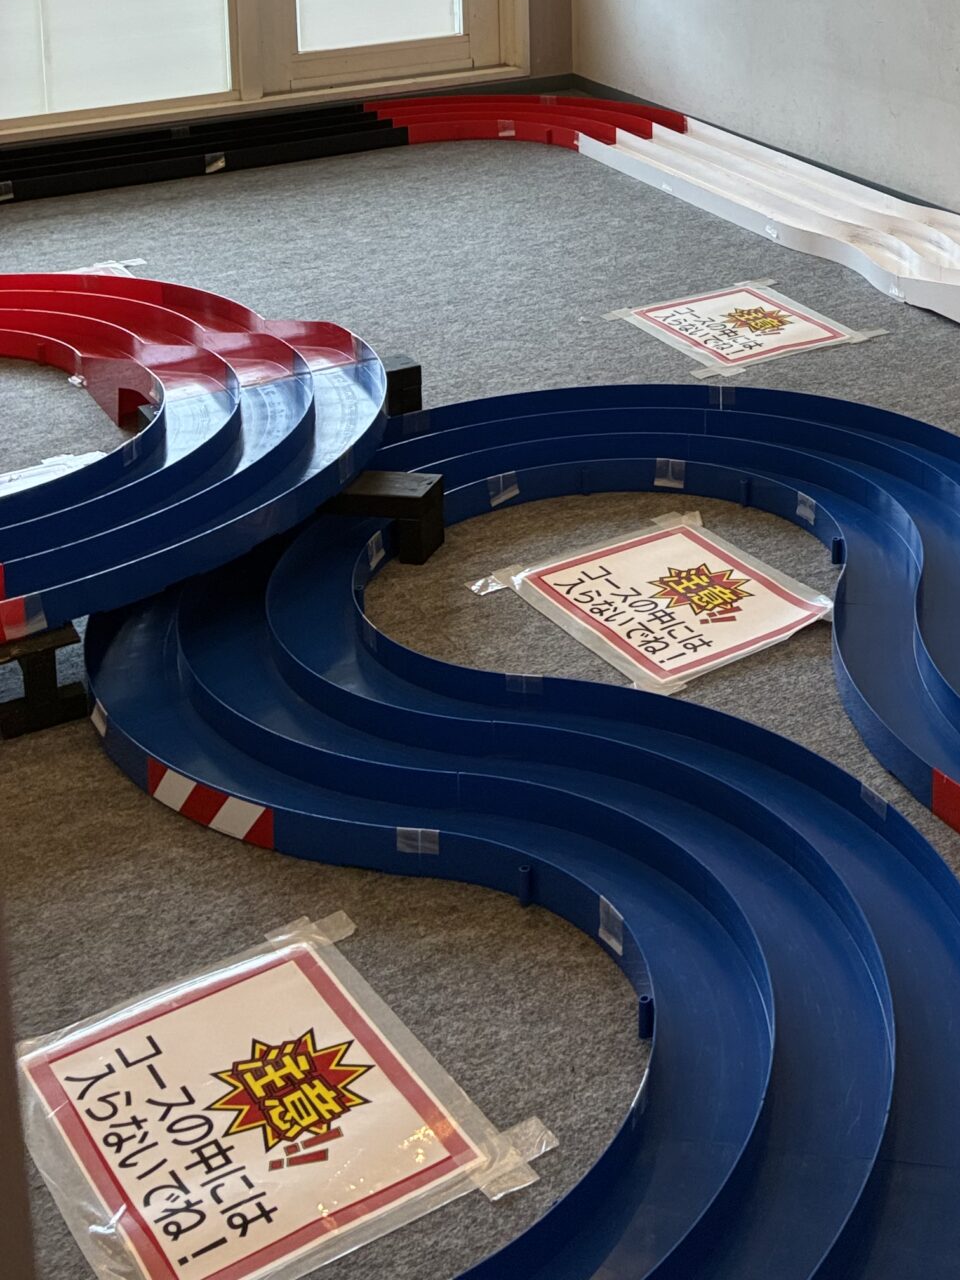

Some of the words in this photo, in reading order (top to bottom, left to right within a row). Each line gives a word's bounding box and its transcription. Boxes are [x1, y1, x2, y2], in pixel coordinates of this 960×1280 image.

[580, 565, 713, 653] コースの中には
[115, 1034, 280, 1238] コースの中には
